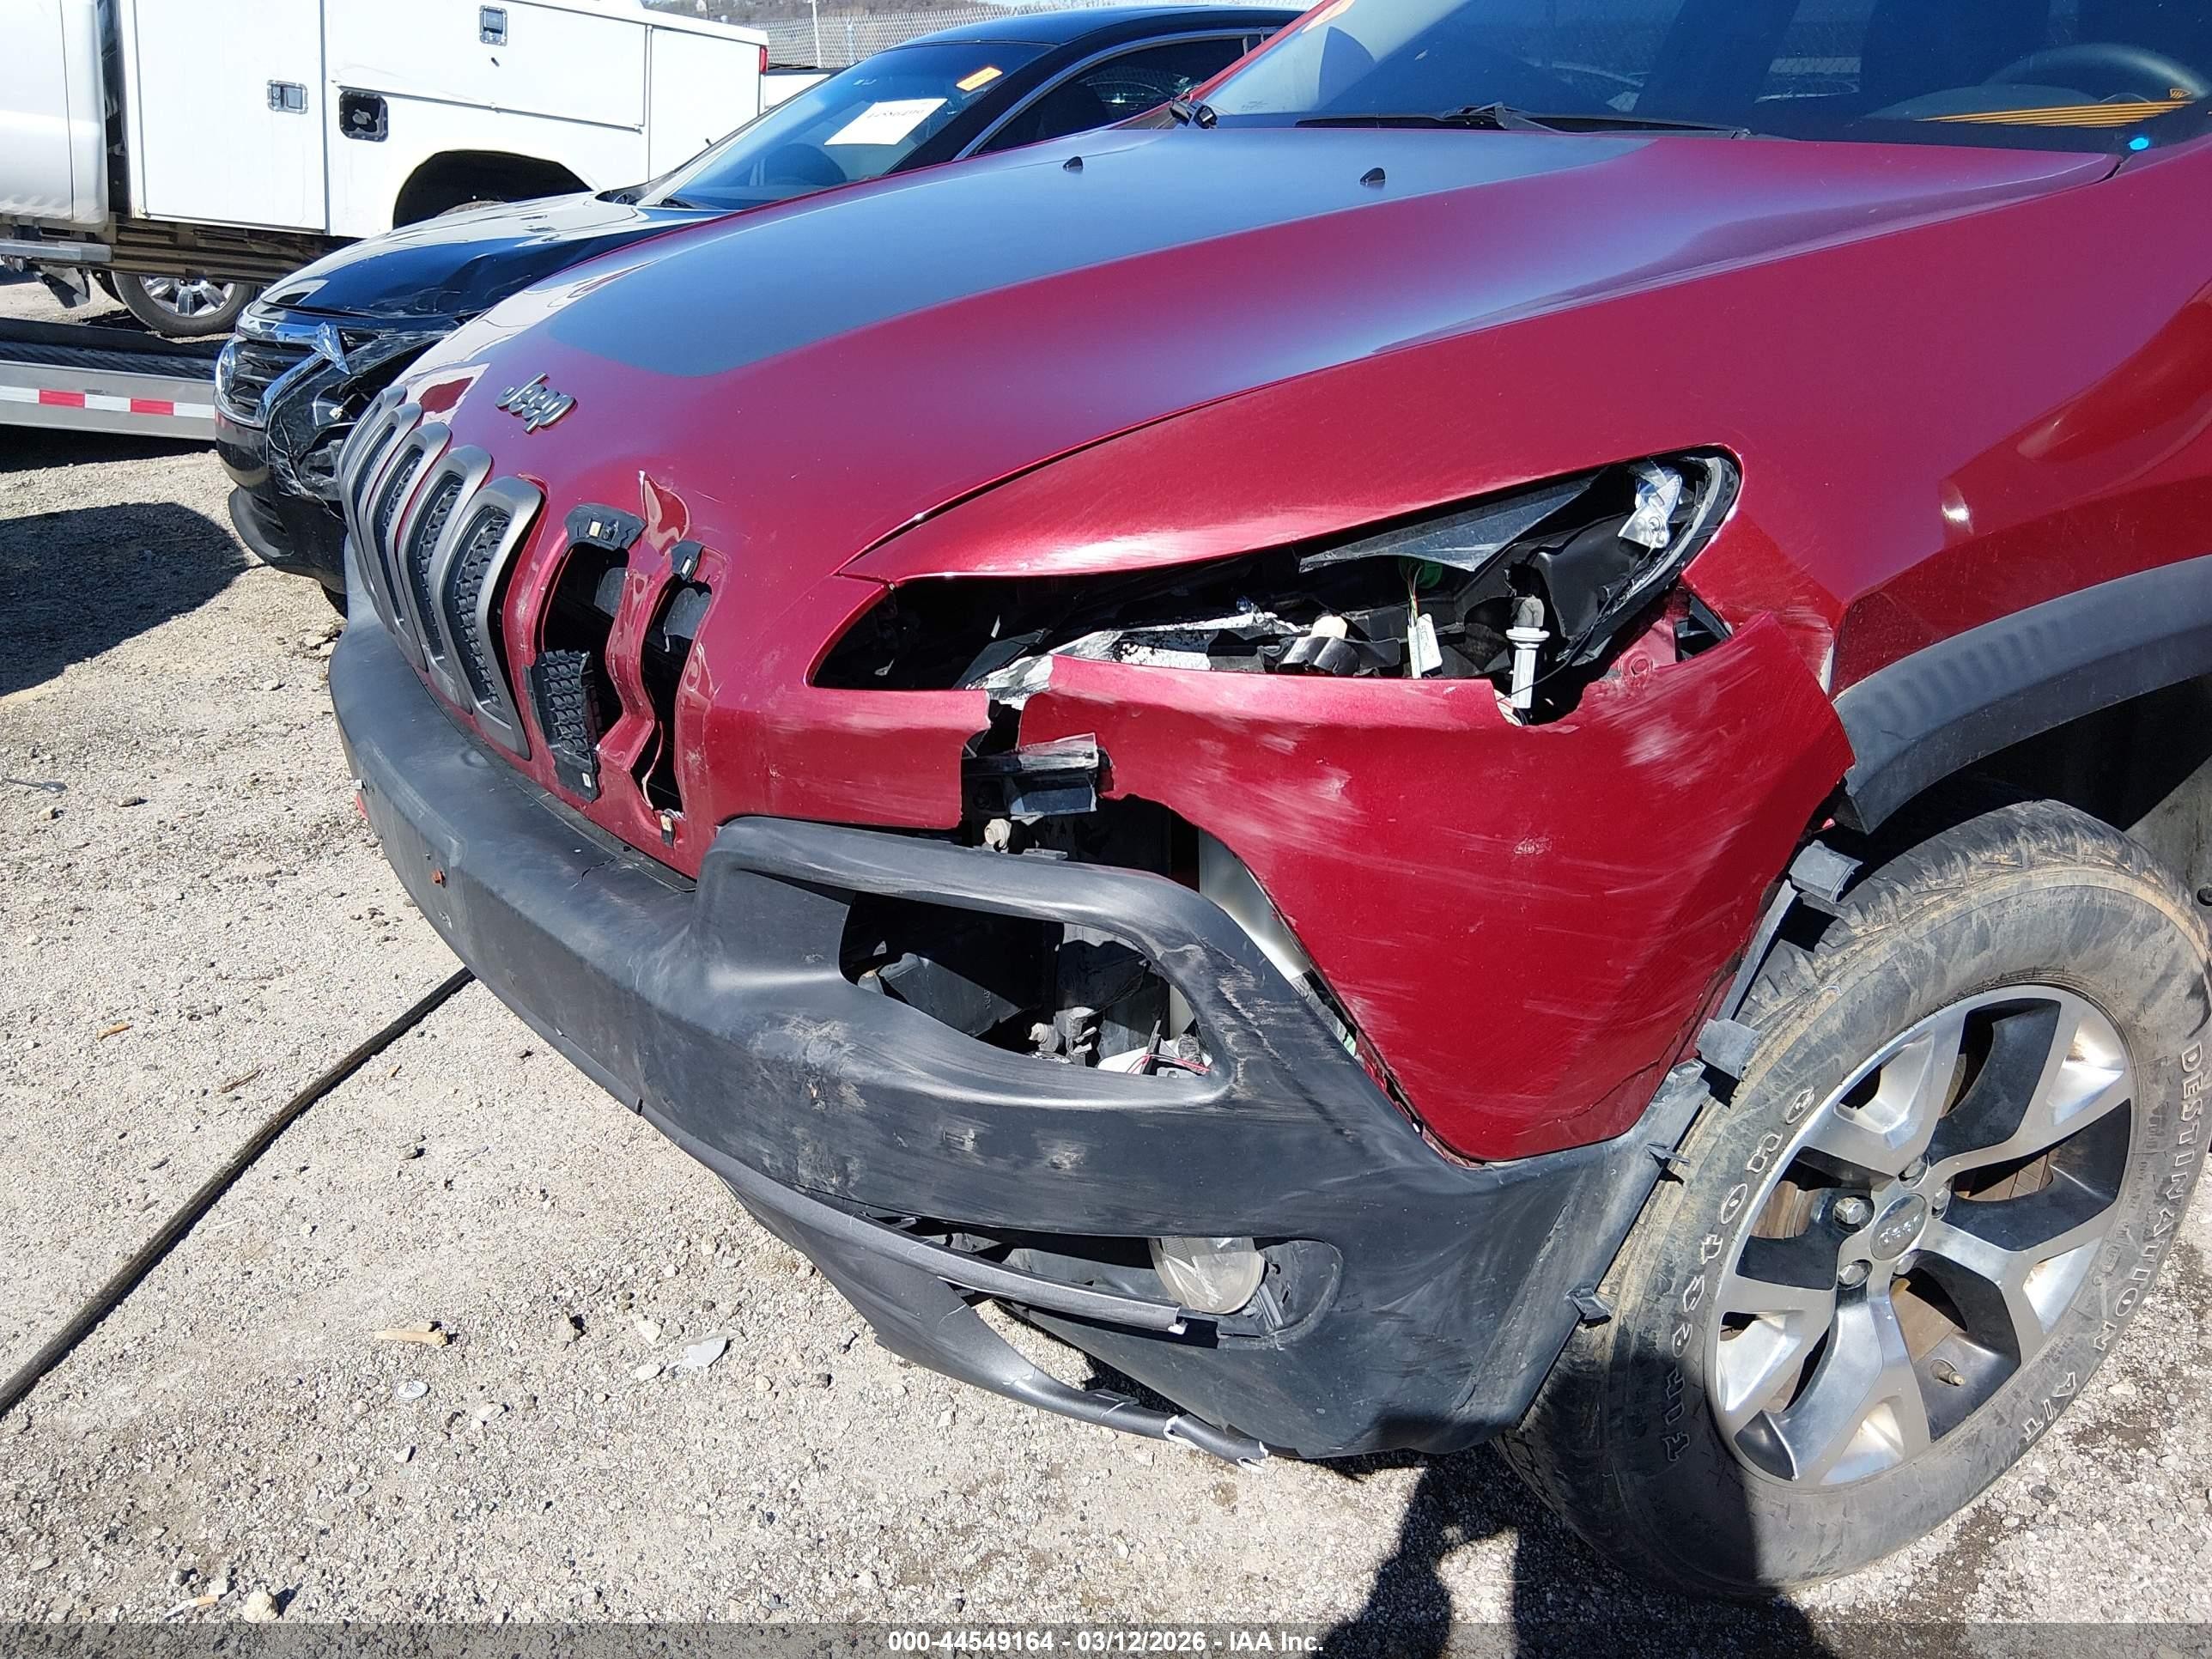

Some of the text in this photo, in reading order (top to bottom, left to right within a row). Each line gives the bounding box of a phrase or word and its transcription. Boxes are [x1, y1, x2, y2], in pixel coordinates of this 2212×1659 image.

[495, 372, 578, 434] Jeep
[2021, 1043, 2204, 1443] DESTINATION A/T
